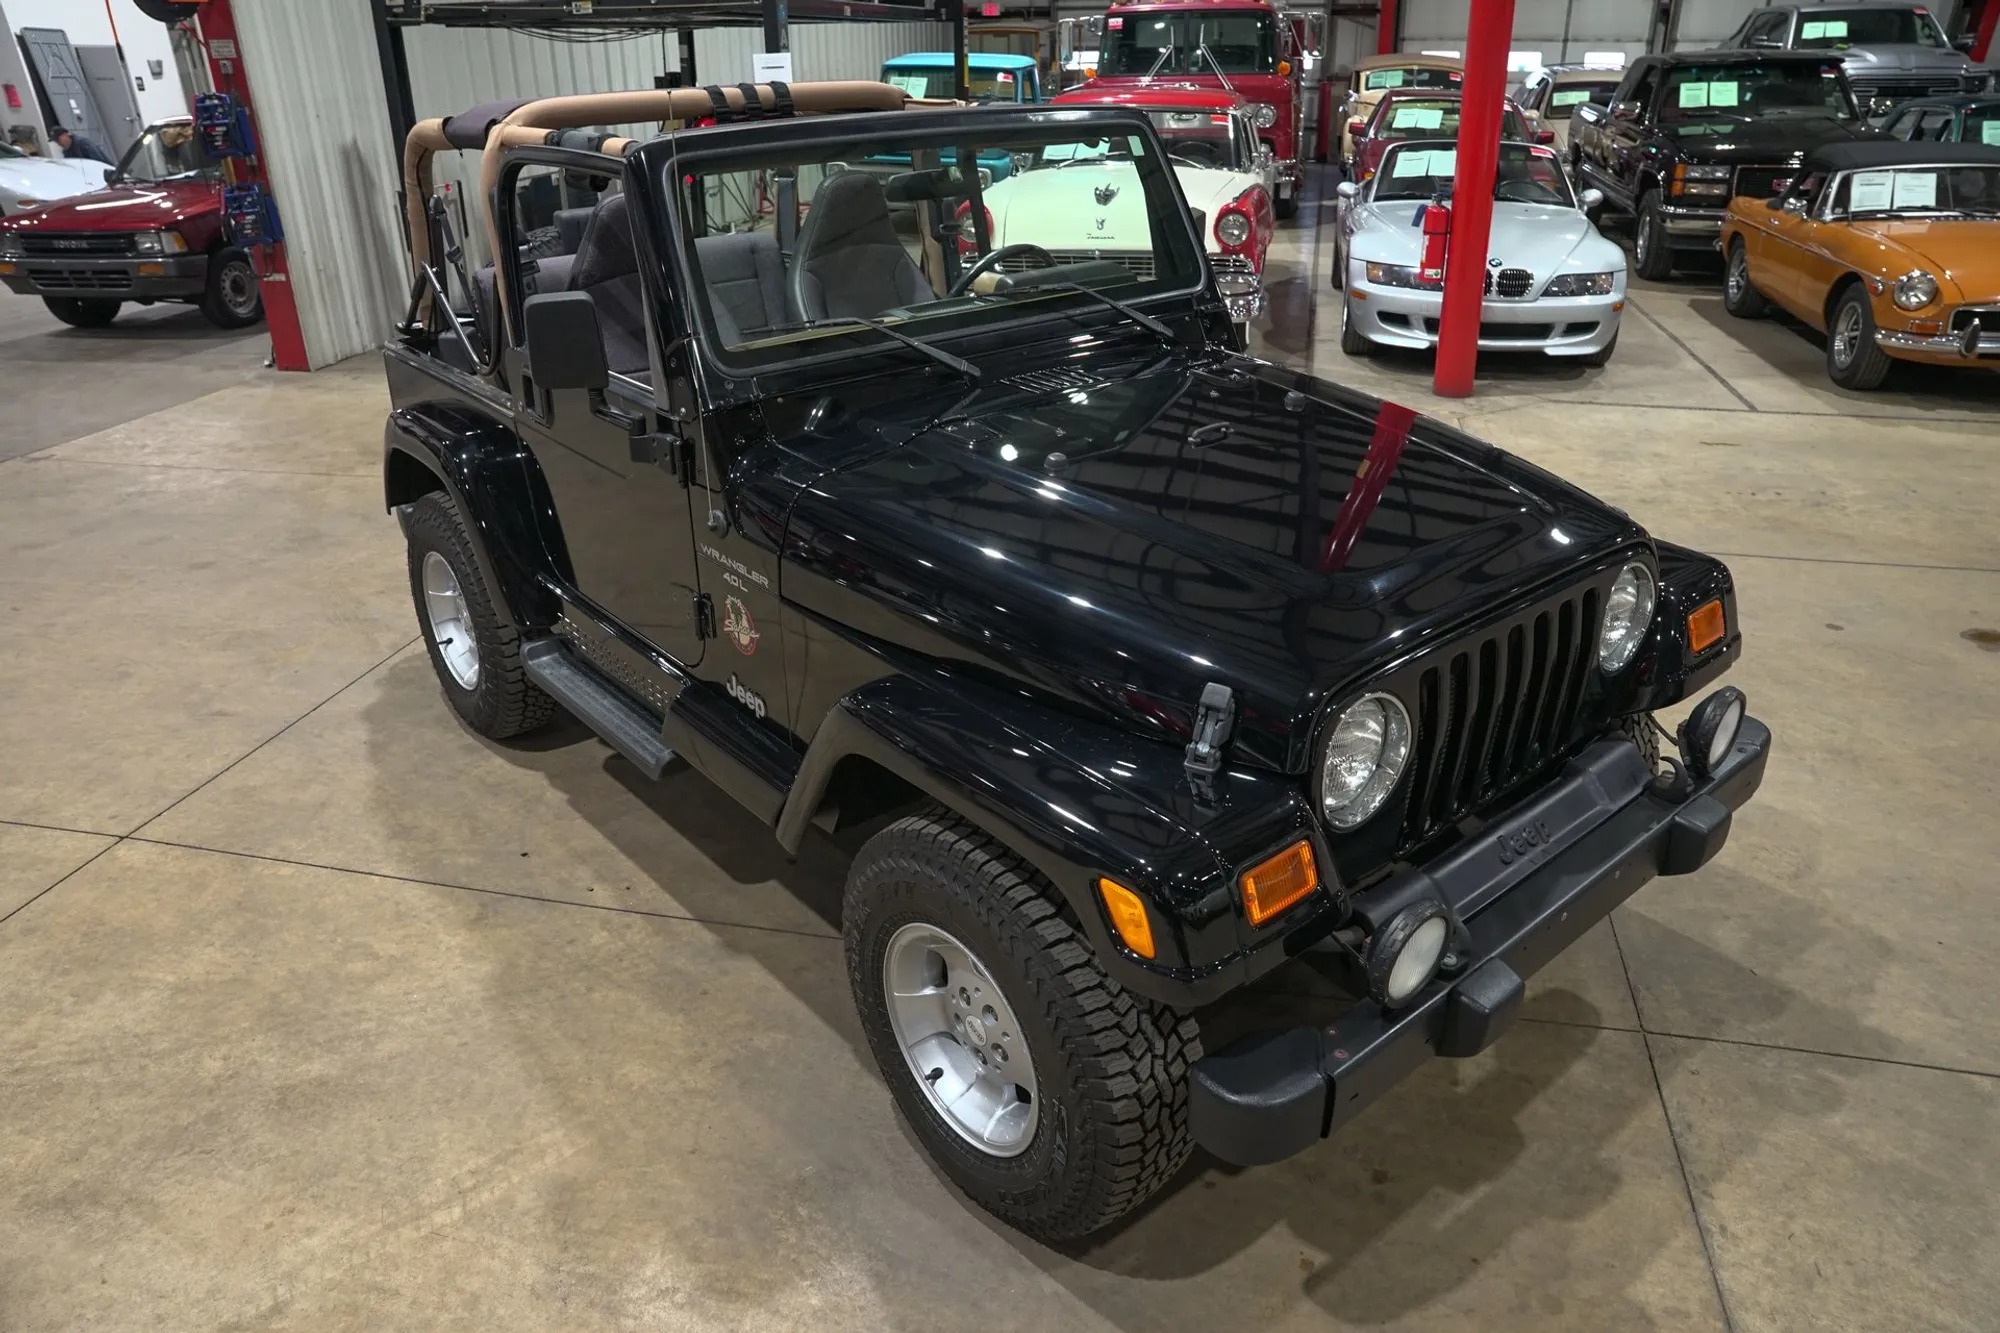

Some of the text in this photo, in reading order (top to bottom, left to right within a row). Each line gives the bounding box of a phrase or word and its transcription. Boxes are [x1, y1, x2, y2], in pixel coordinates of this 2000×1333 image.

[700, 542, 769, 589] WRANGLER
[726, 674, 765, 720] Jeep
[1496, 819, 1550, 865] Jeep
